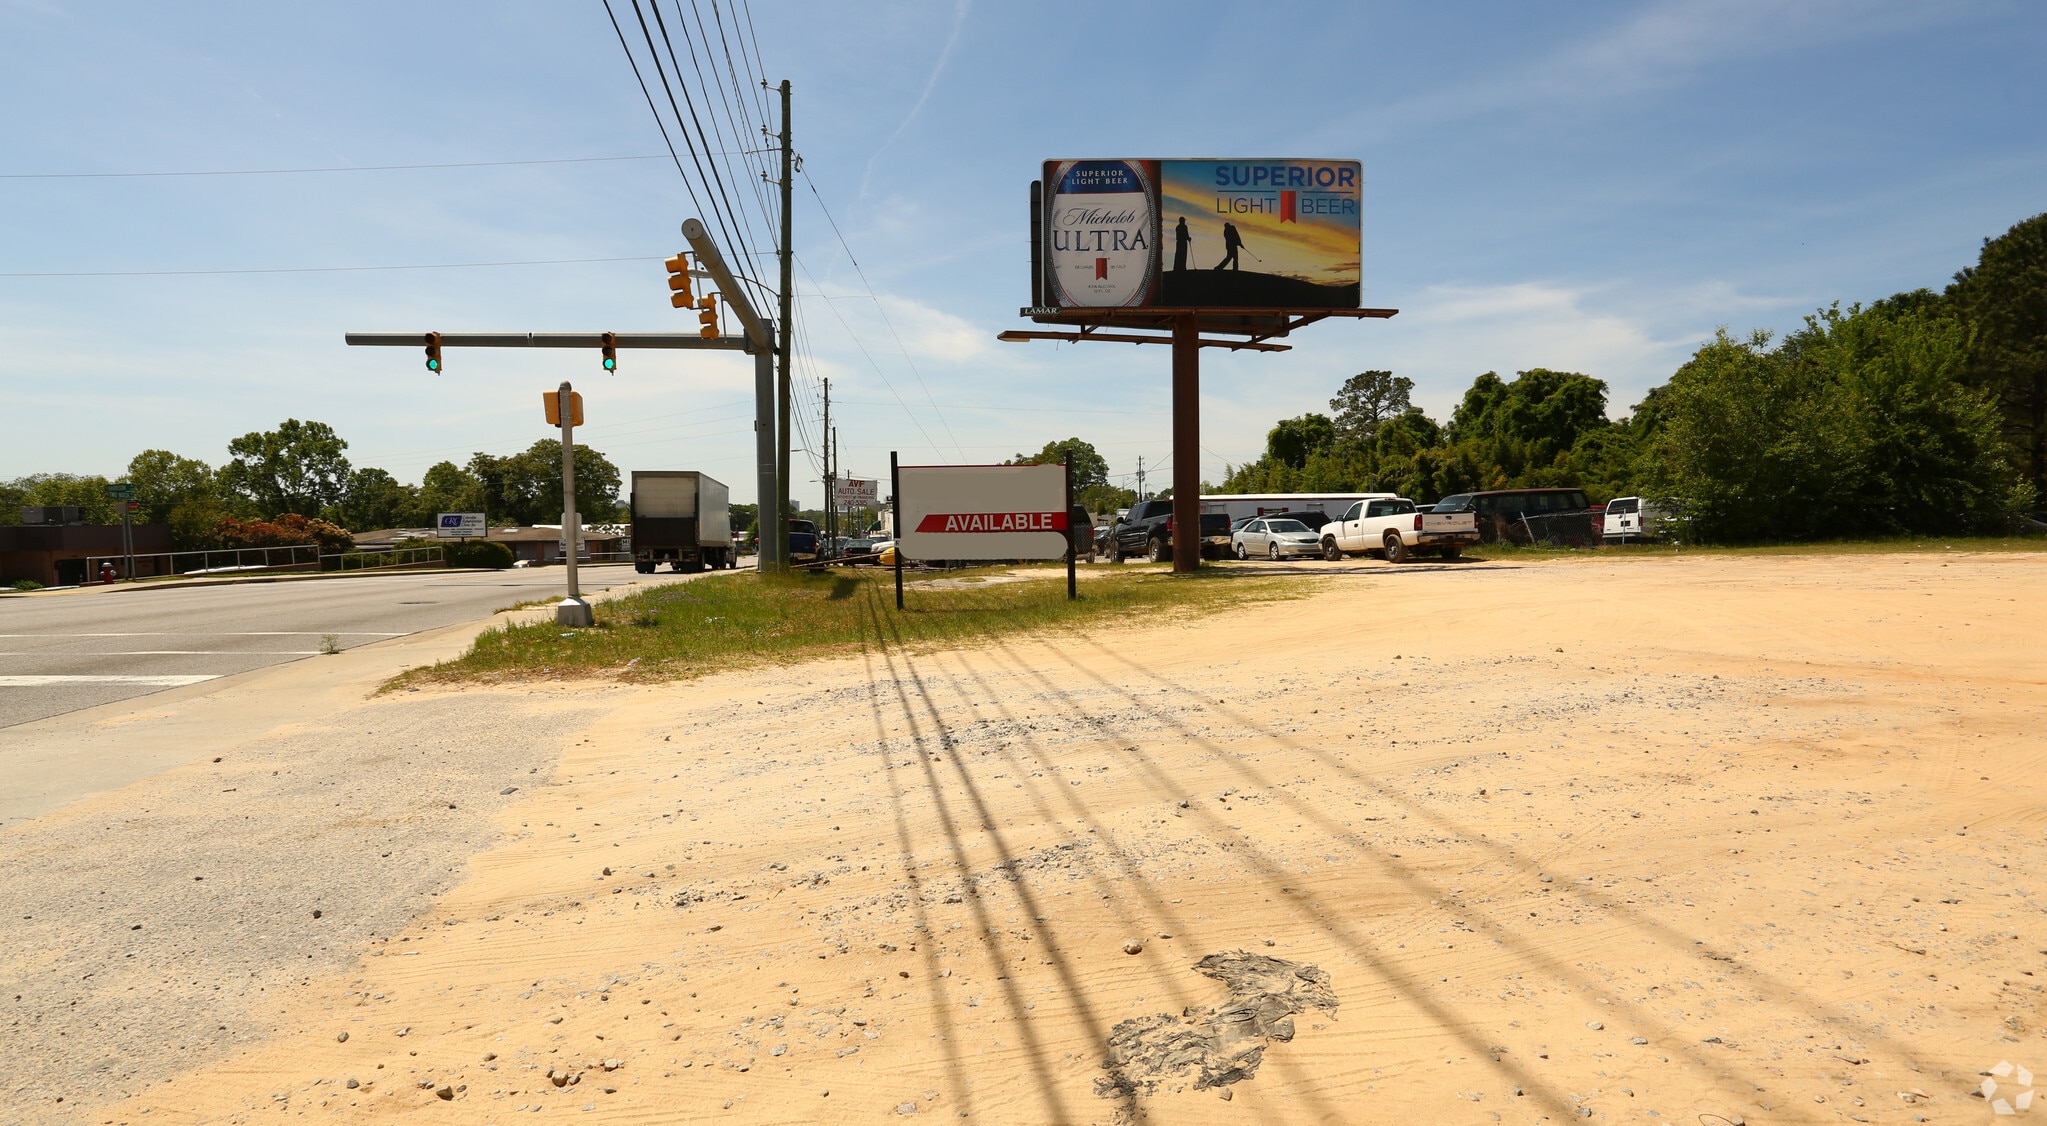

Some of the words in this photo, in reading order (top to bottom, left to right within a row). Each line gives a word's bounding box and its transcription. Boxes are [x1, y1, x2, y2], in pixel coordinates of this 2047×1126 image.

[1215, 165, 1355, 187] SUPERIOR
[1216, 197, 1277, 214] LIGHT
[1301, 198, 1355, 214] BEER
[1062, 207, 1136, 226] Michelob
[1053, 228, 1147, 251] ULTRA
[944, 513, 1053, 531] AVAILABLE
